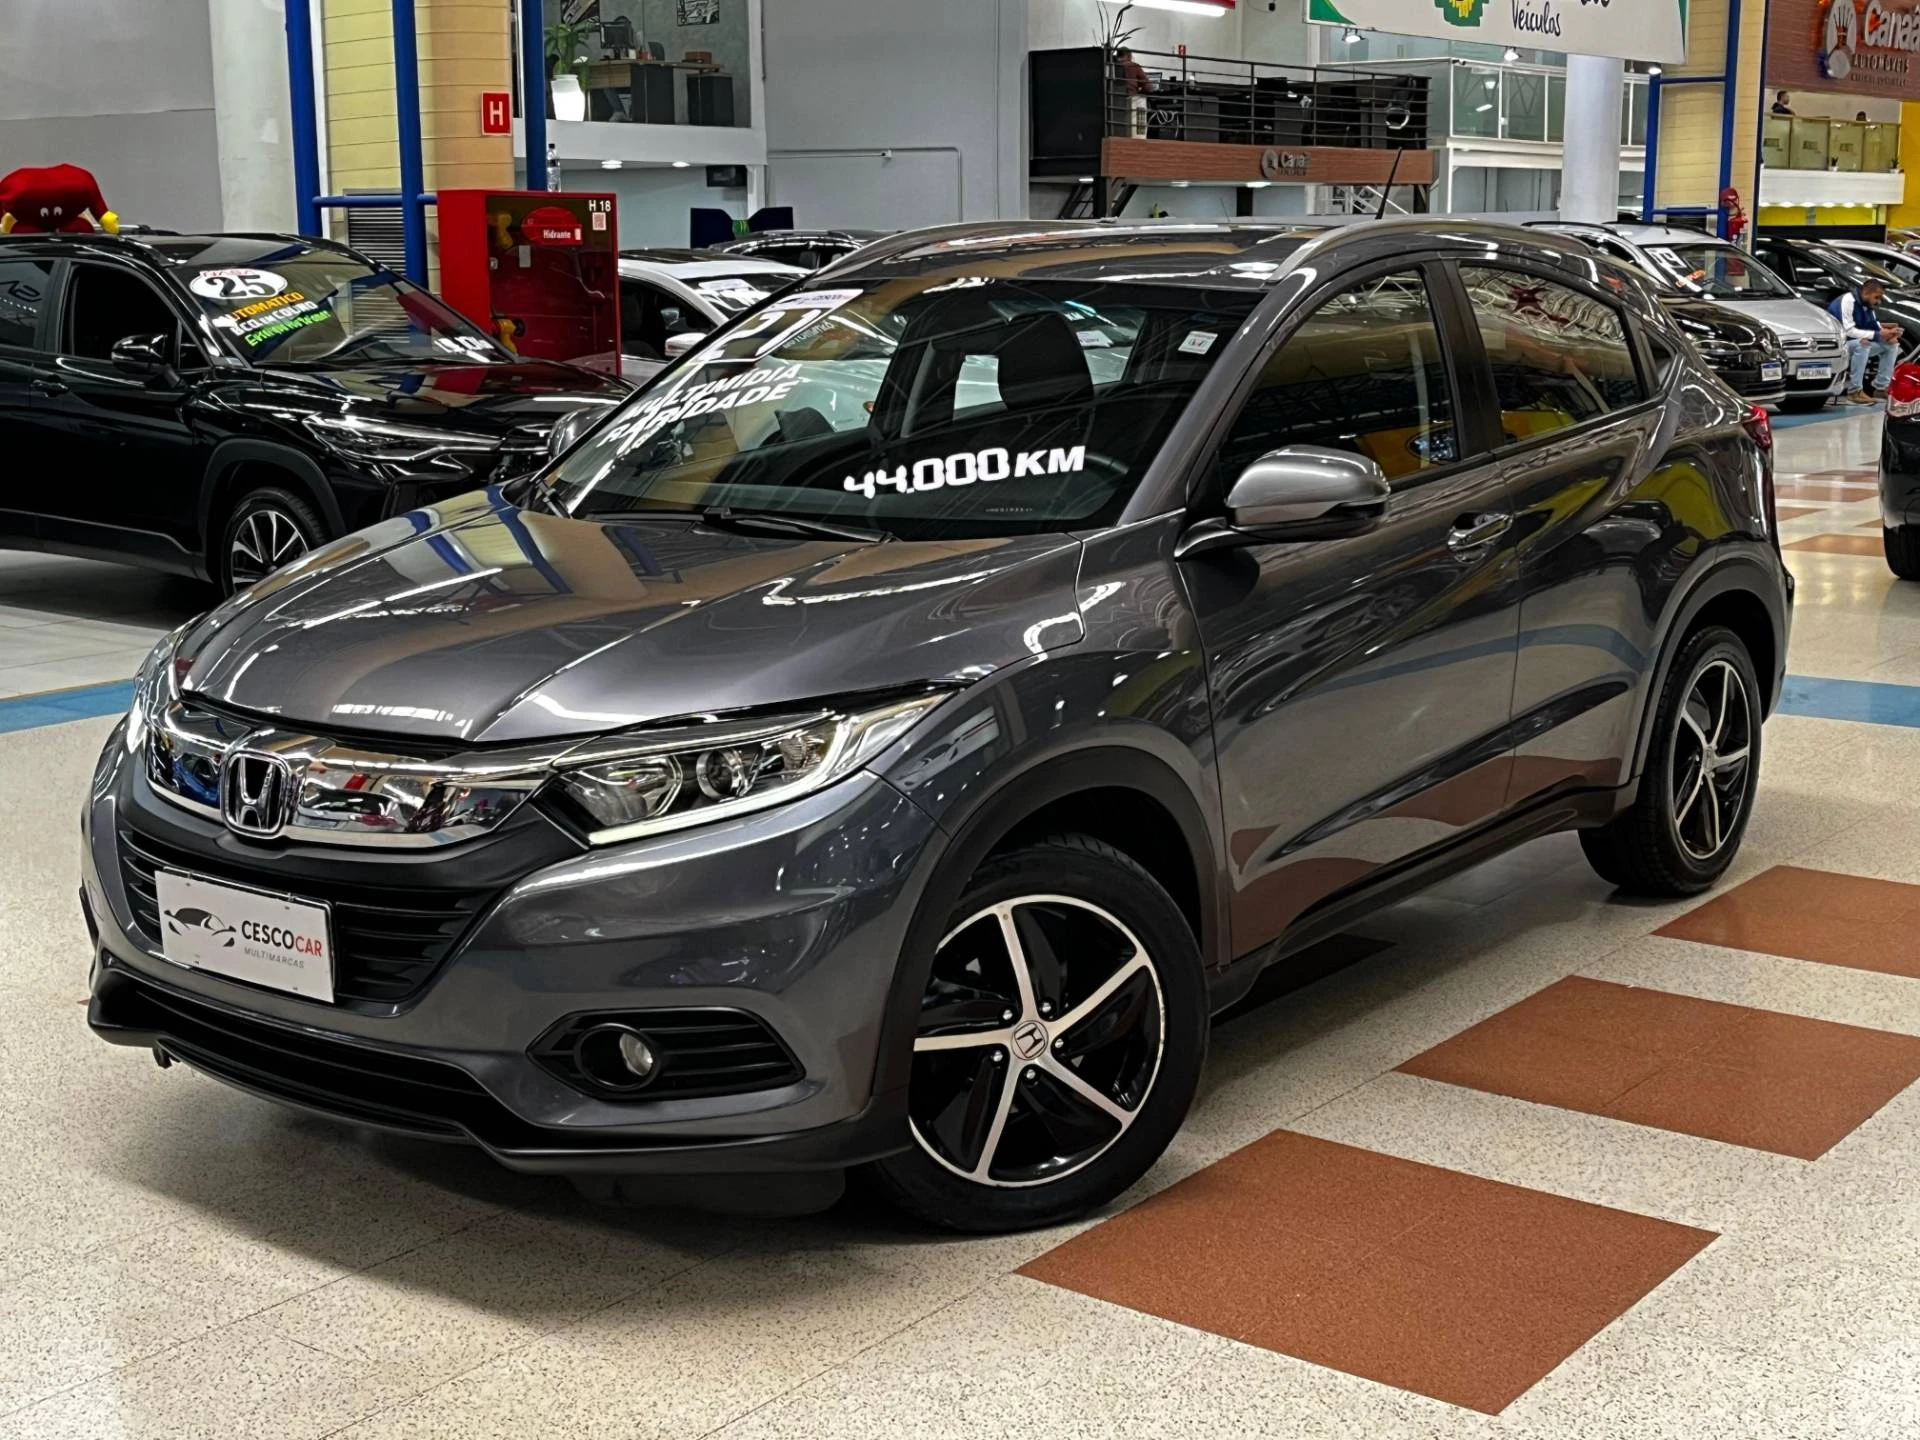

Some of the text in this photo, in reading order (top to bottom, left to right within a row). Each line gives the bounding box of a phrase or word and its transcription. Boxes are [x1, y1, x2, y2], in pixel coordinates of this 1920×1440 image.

[489, 101, 503, 126] H
[589, 200, 596, 212] H
[543, 229, 571, 239] Hidrante
[205, 275, 276, 297] 25
[214, 292, 304, 323] UTOMATICO
[843, 445, 1086, 499] 44.000 KM
[241, 920, 322, 957] CESCOCAR
[243, 947, 305, 969] MULTIMARCAS
